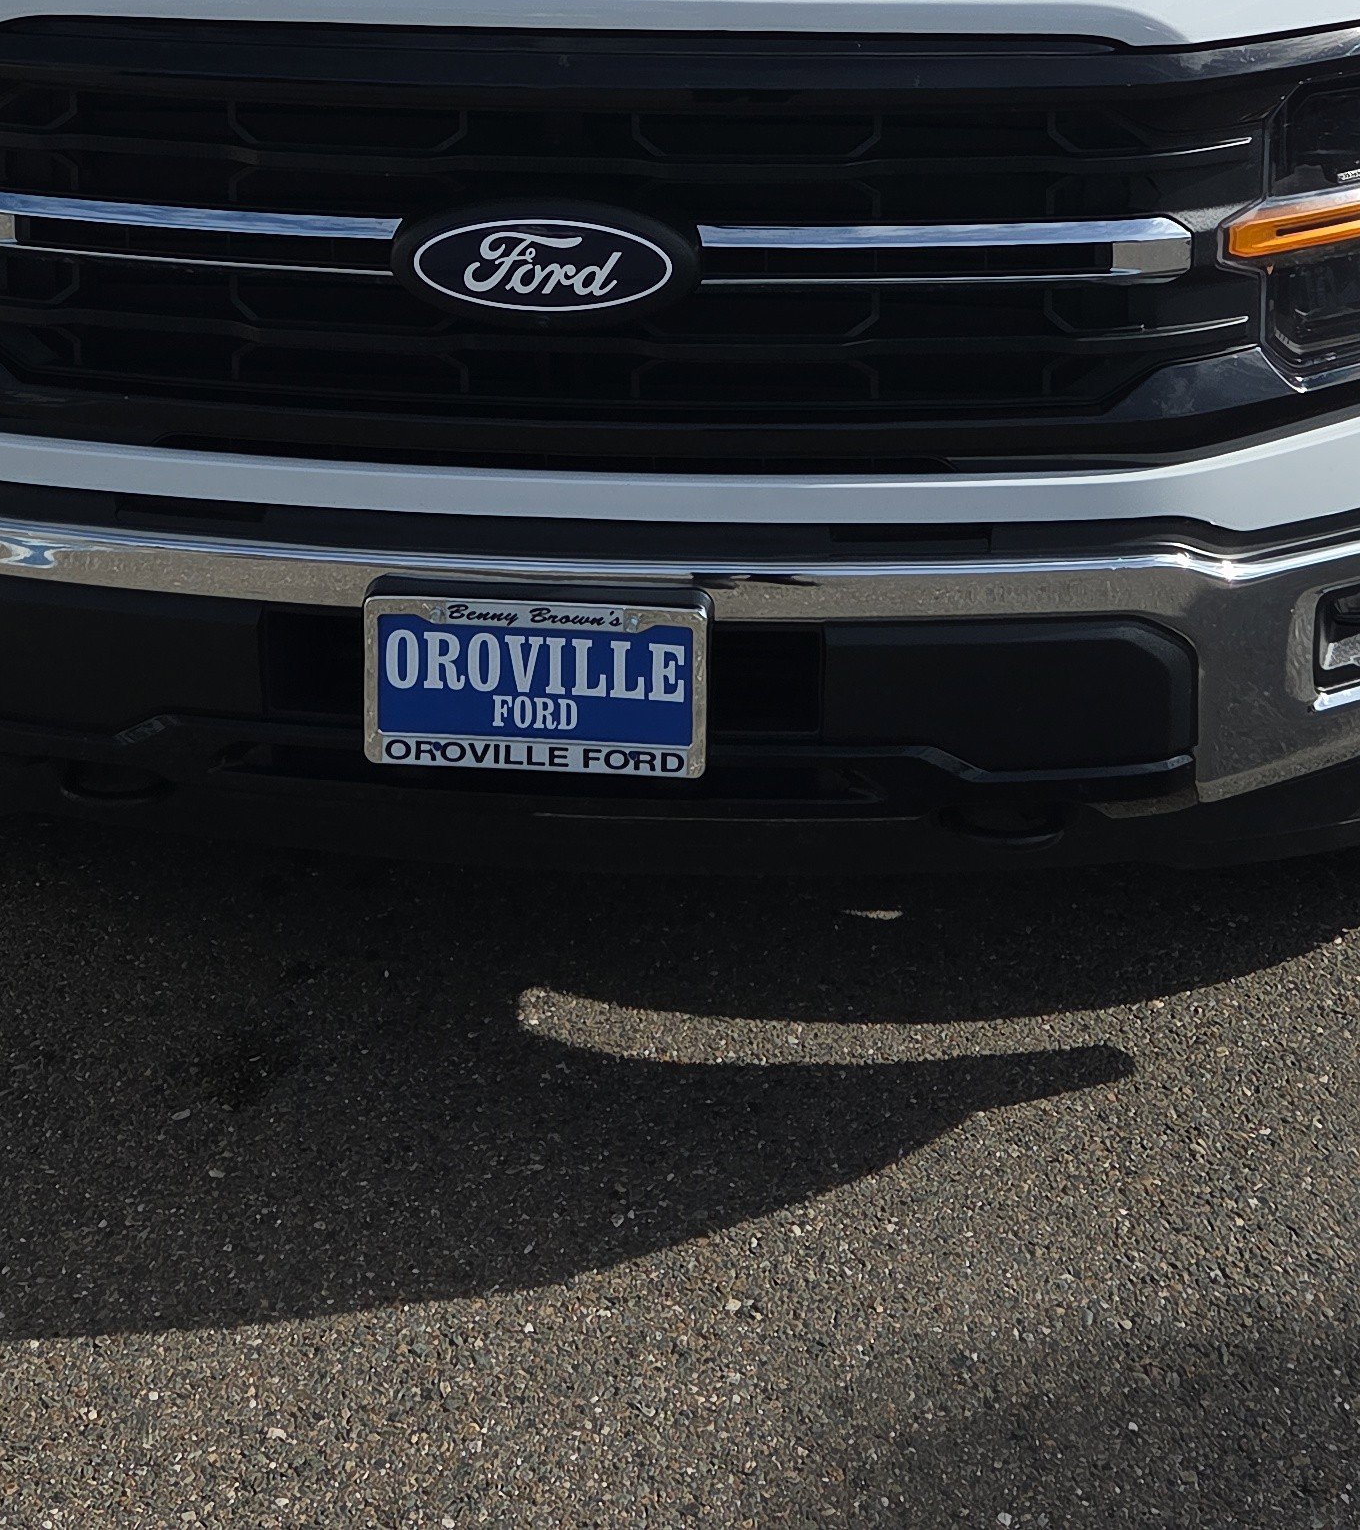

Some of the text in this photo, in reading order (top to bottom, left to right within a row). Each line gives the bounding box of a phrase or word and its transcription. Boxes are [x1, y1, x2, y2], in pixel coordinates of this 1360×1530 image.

[463, 231, 622, 296] Ford
[447, 604, 622, 628] Benny Brown's
[385, 629, 685, 702] OROVILLE
[492, 695, 578, 730] FORD
[385, 739, 685, 774] OROVILLE FORD
